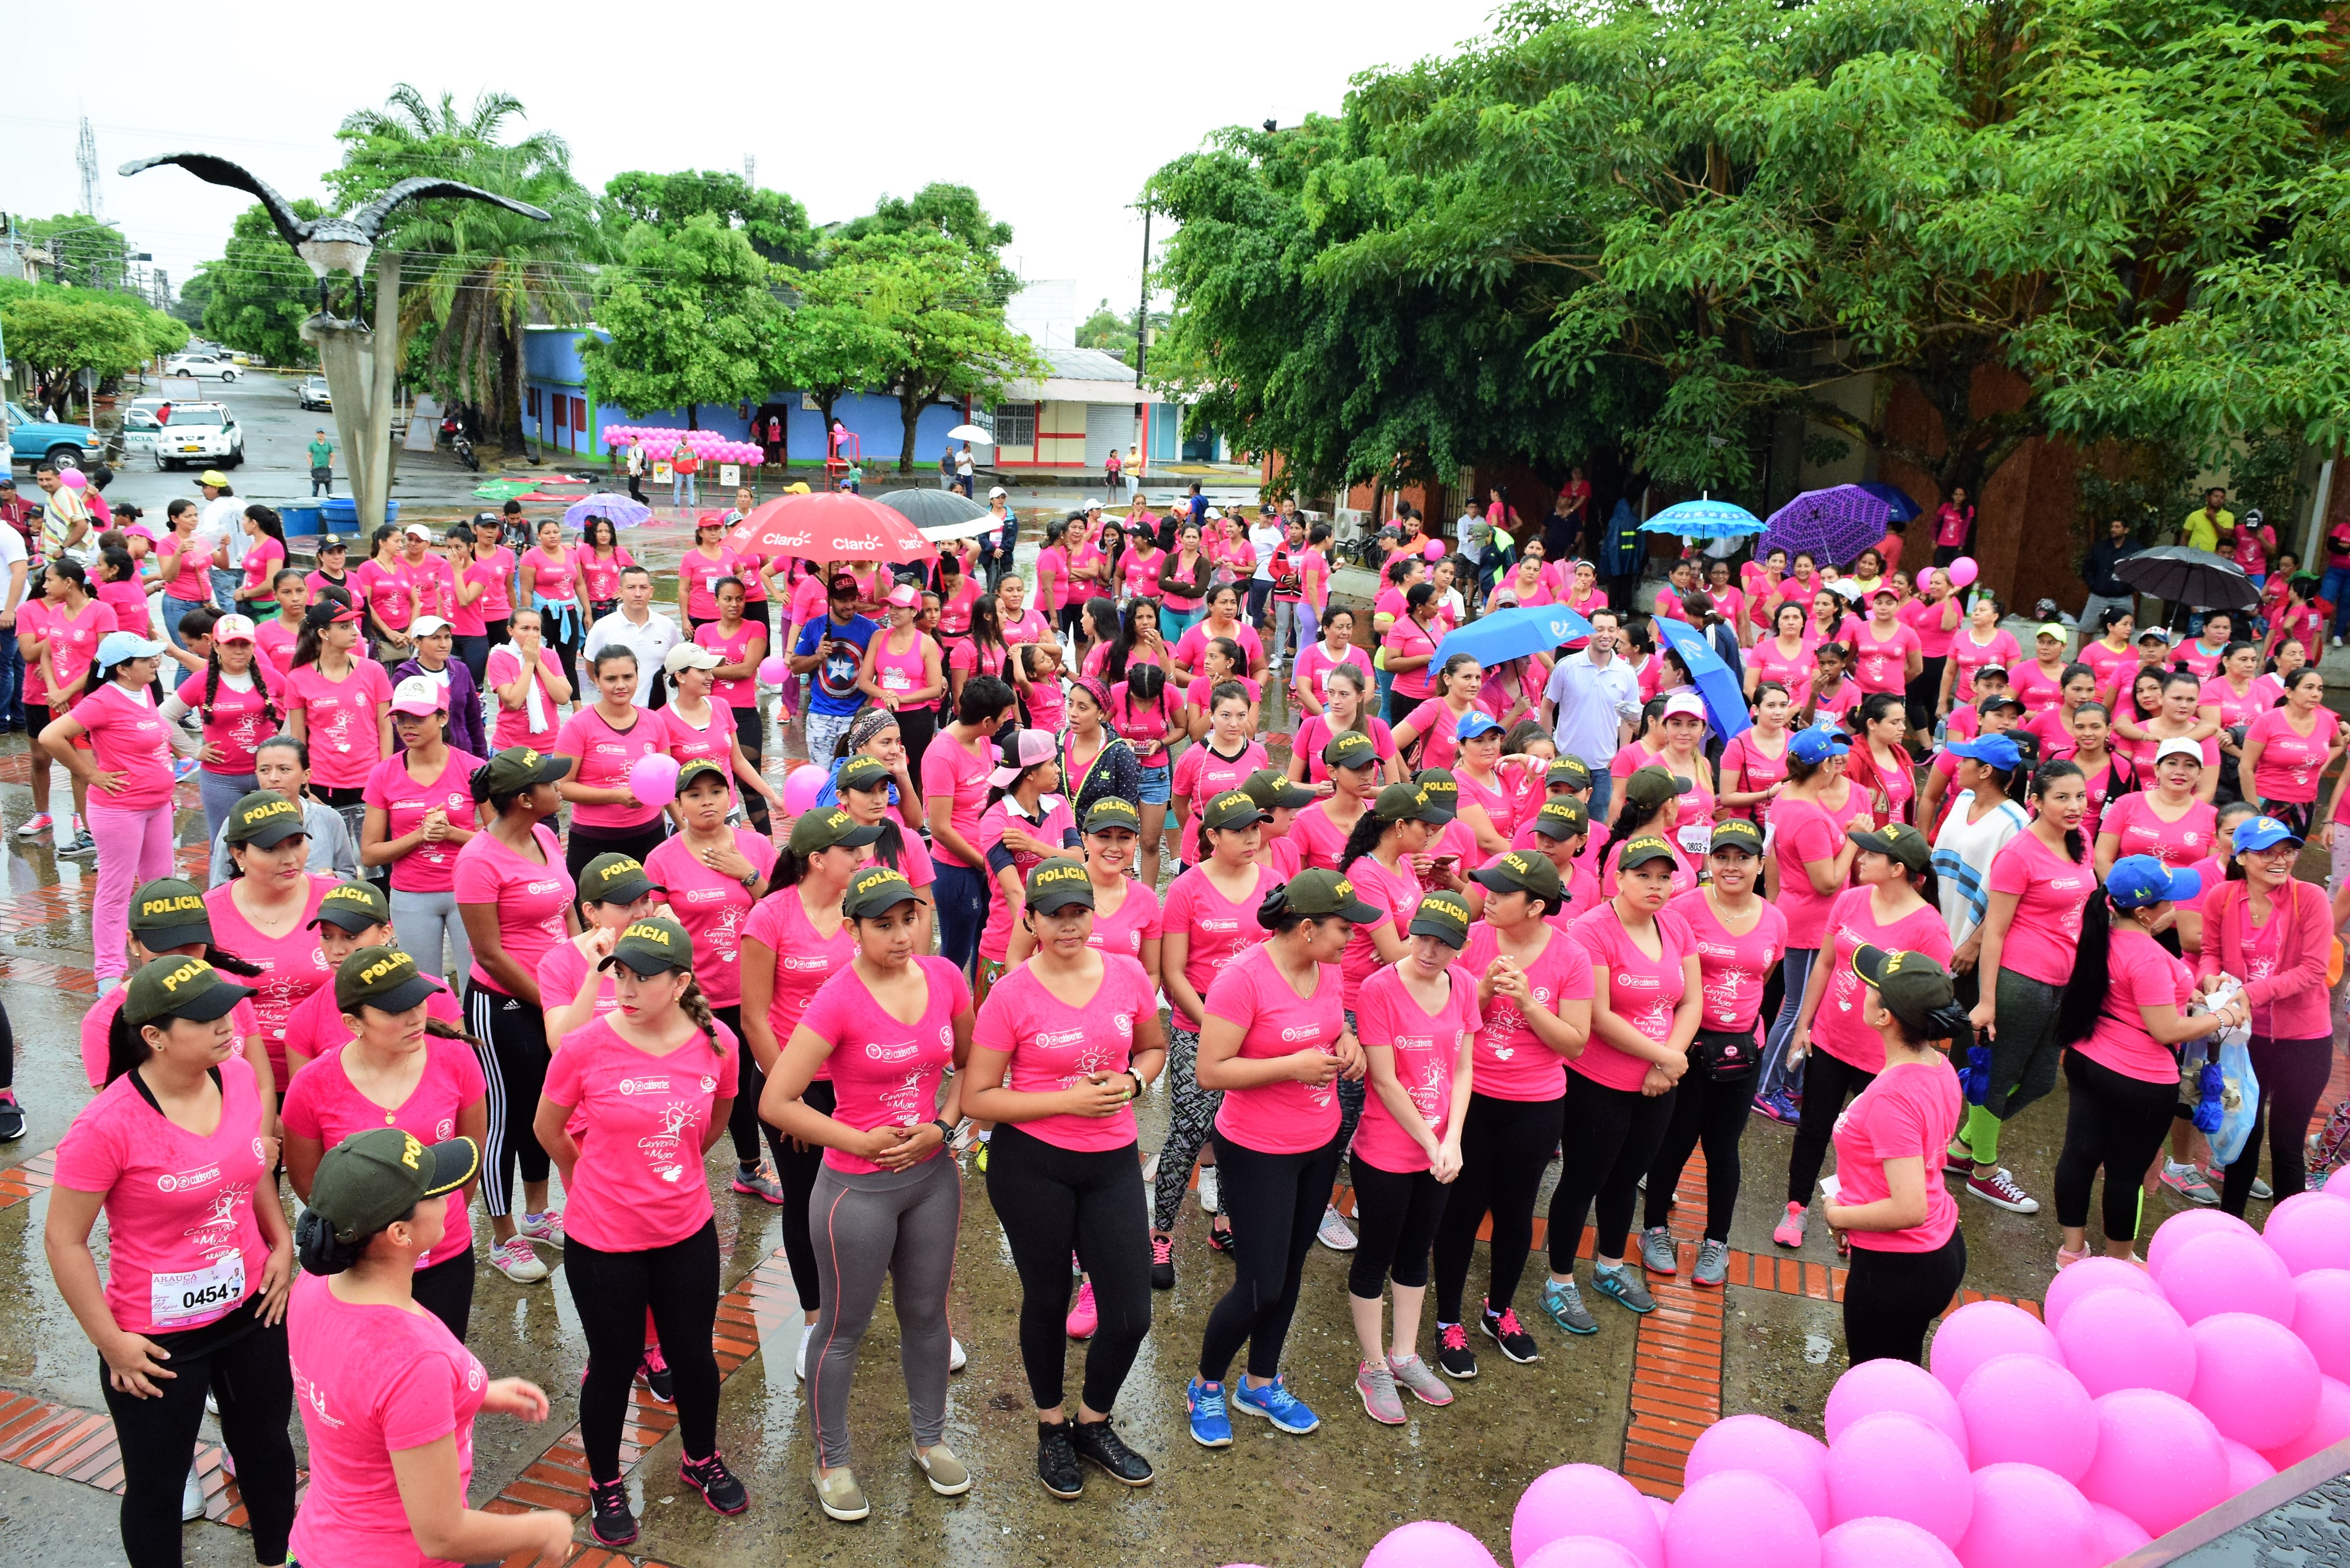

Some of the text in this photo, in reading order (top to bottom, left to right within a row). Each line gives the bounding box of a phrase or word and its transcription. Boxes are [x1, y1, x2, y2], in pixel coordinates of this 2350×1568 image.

[763, 532, 805, 547] Claro
[832, 537, 877, 550] Claro
[1549, 760, 1584, 774] POLICIA
[1423, 782, 1457, 791] POLICIA
[1093, 801, 1136, 816] POLICIA
[1541, 803, 1576, 821] OLICIA
[1713, 822, 1756, 837] POLICIA
[1686, 843, 1702, 852] 0803
[1036, 867, 1088, 886] POLICIA
[321, 887, 373, 905] OLICIA
[143, 896, 204, 916] POLICIA
[1421, 898, 1469, 925] POLICIA
[619, 924, 670, 946] OLICIA
[1703, 984, 1732, 997] Carrera
[1712, 995, 1734, 1007] Mujer
[1487, 1026, 1512, 1041] Mujer
[1646, 1026, 1667, 1036] Mujer
[1058, 1033, 1084, 1044] coldeportes
[893, 1045, 918, 1059] coldeportes
[643, 1080, 670, 1091] coldeportes
[880, 1090, 915, 1102] Carrera
[892, 1099, 917, 1110] Mujer
[637, 1137, 675, 1148] Carrera
[649, 1149, 676, 1161] Mujer
[190, 1167, 221, 1186] coldeportes
[183, 1224, 232, 1237] Carrera
[205, 1248, 229, 1261] ARAUCA
[152, 1273, 197, 1283] ARAUCA
[182, 1284, 228, 1308] 0454
